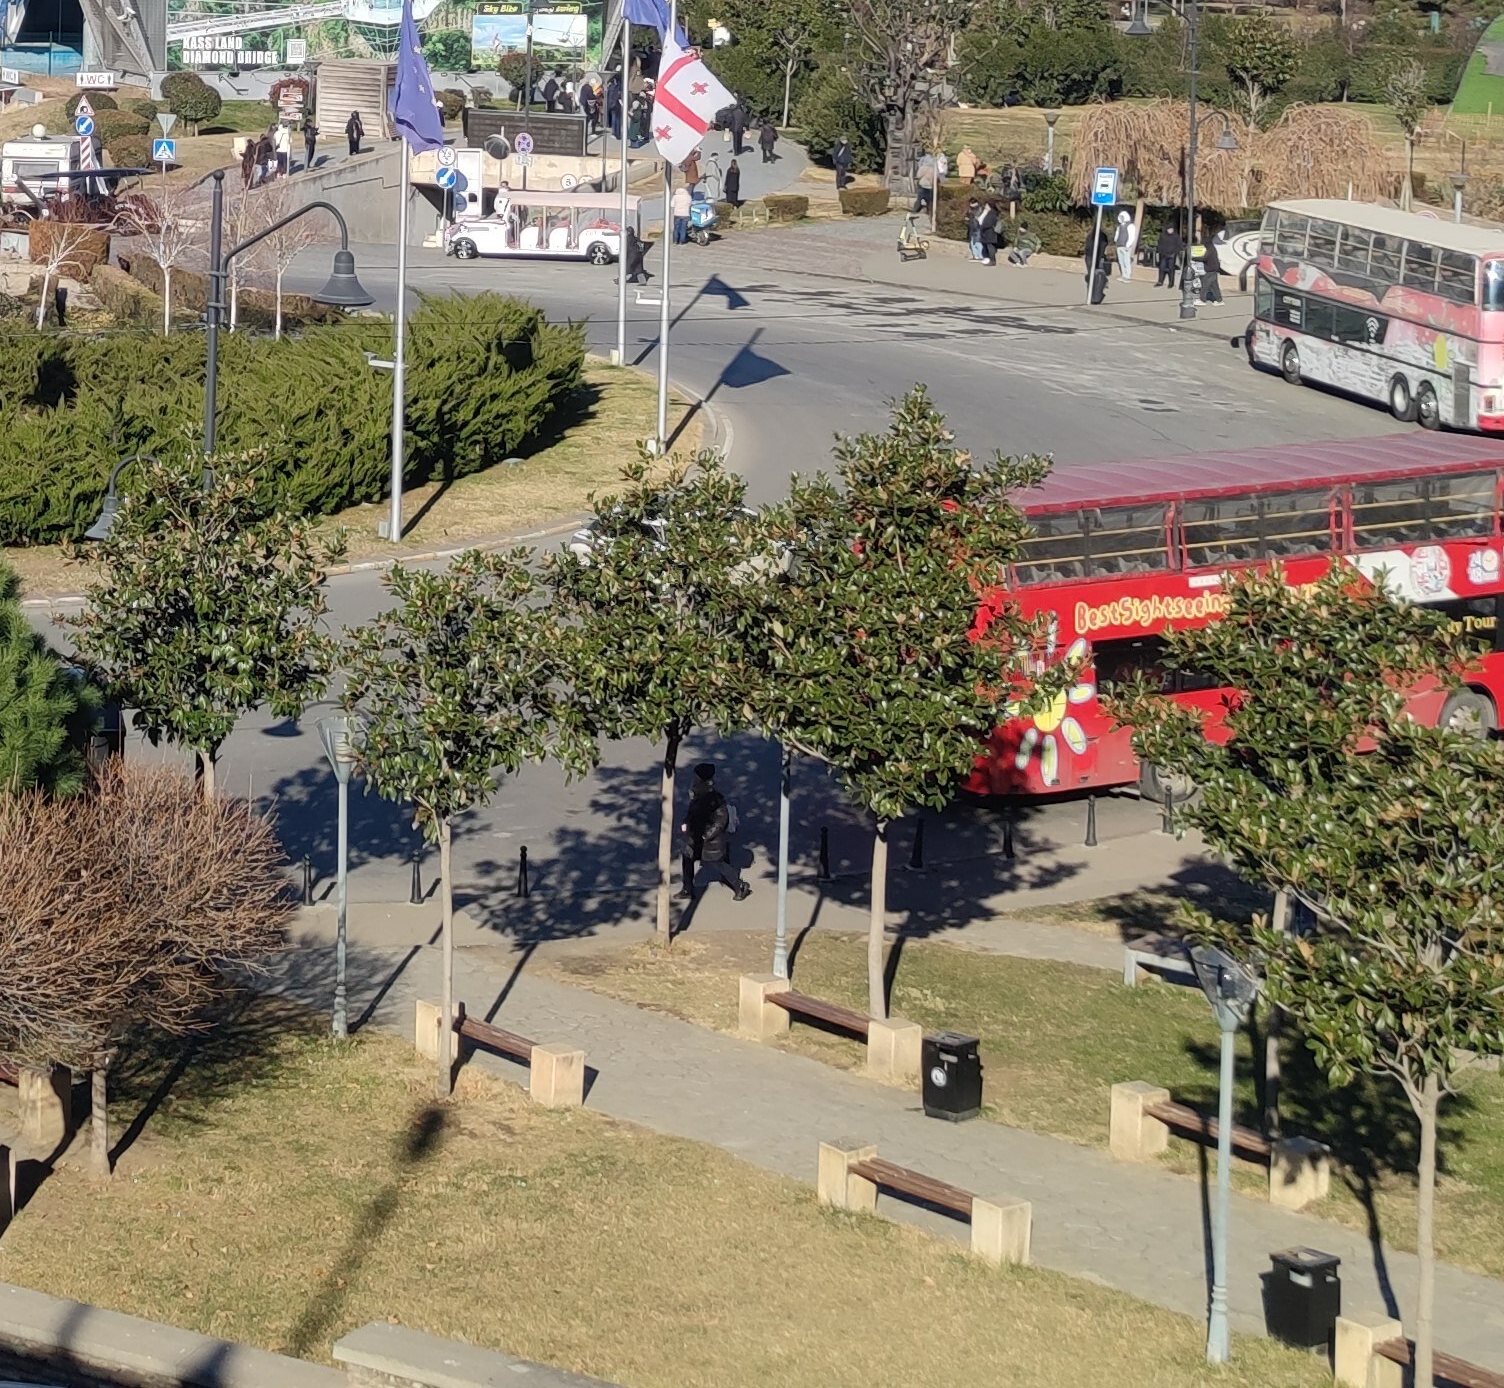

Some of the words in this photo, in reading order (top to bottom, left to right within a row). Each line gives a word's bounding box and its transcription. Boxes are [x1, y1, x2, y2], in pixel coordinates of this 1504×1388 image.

[216, 37, 243, 50] LAND
[183, 51, 234, 64] DIAMOND
[237, 51, 279, 64] BRIDGE
[86, 74, 105, 84] WC
[1463, 615, 1498, 633] Tour
